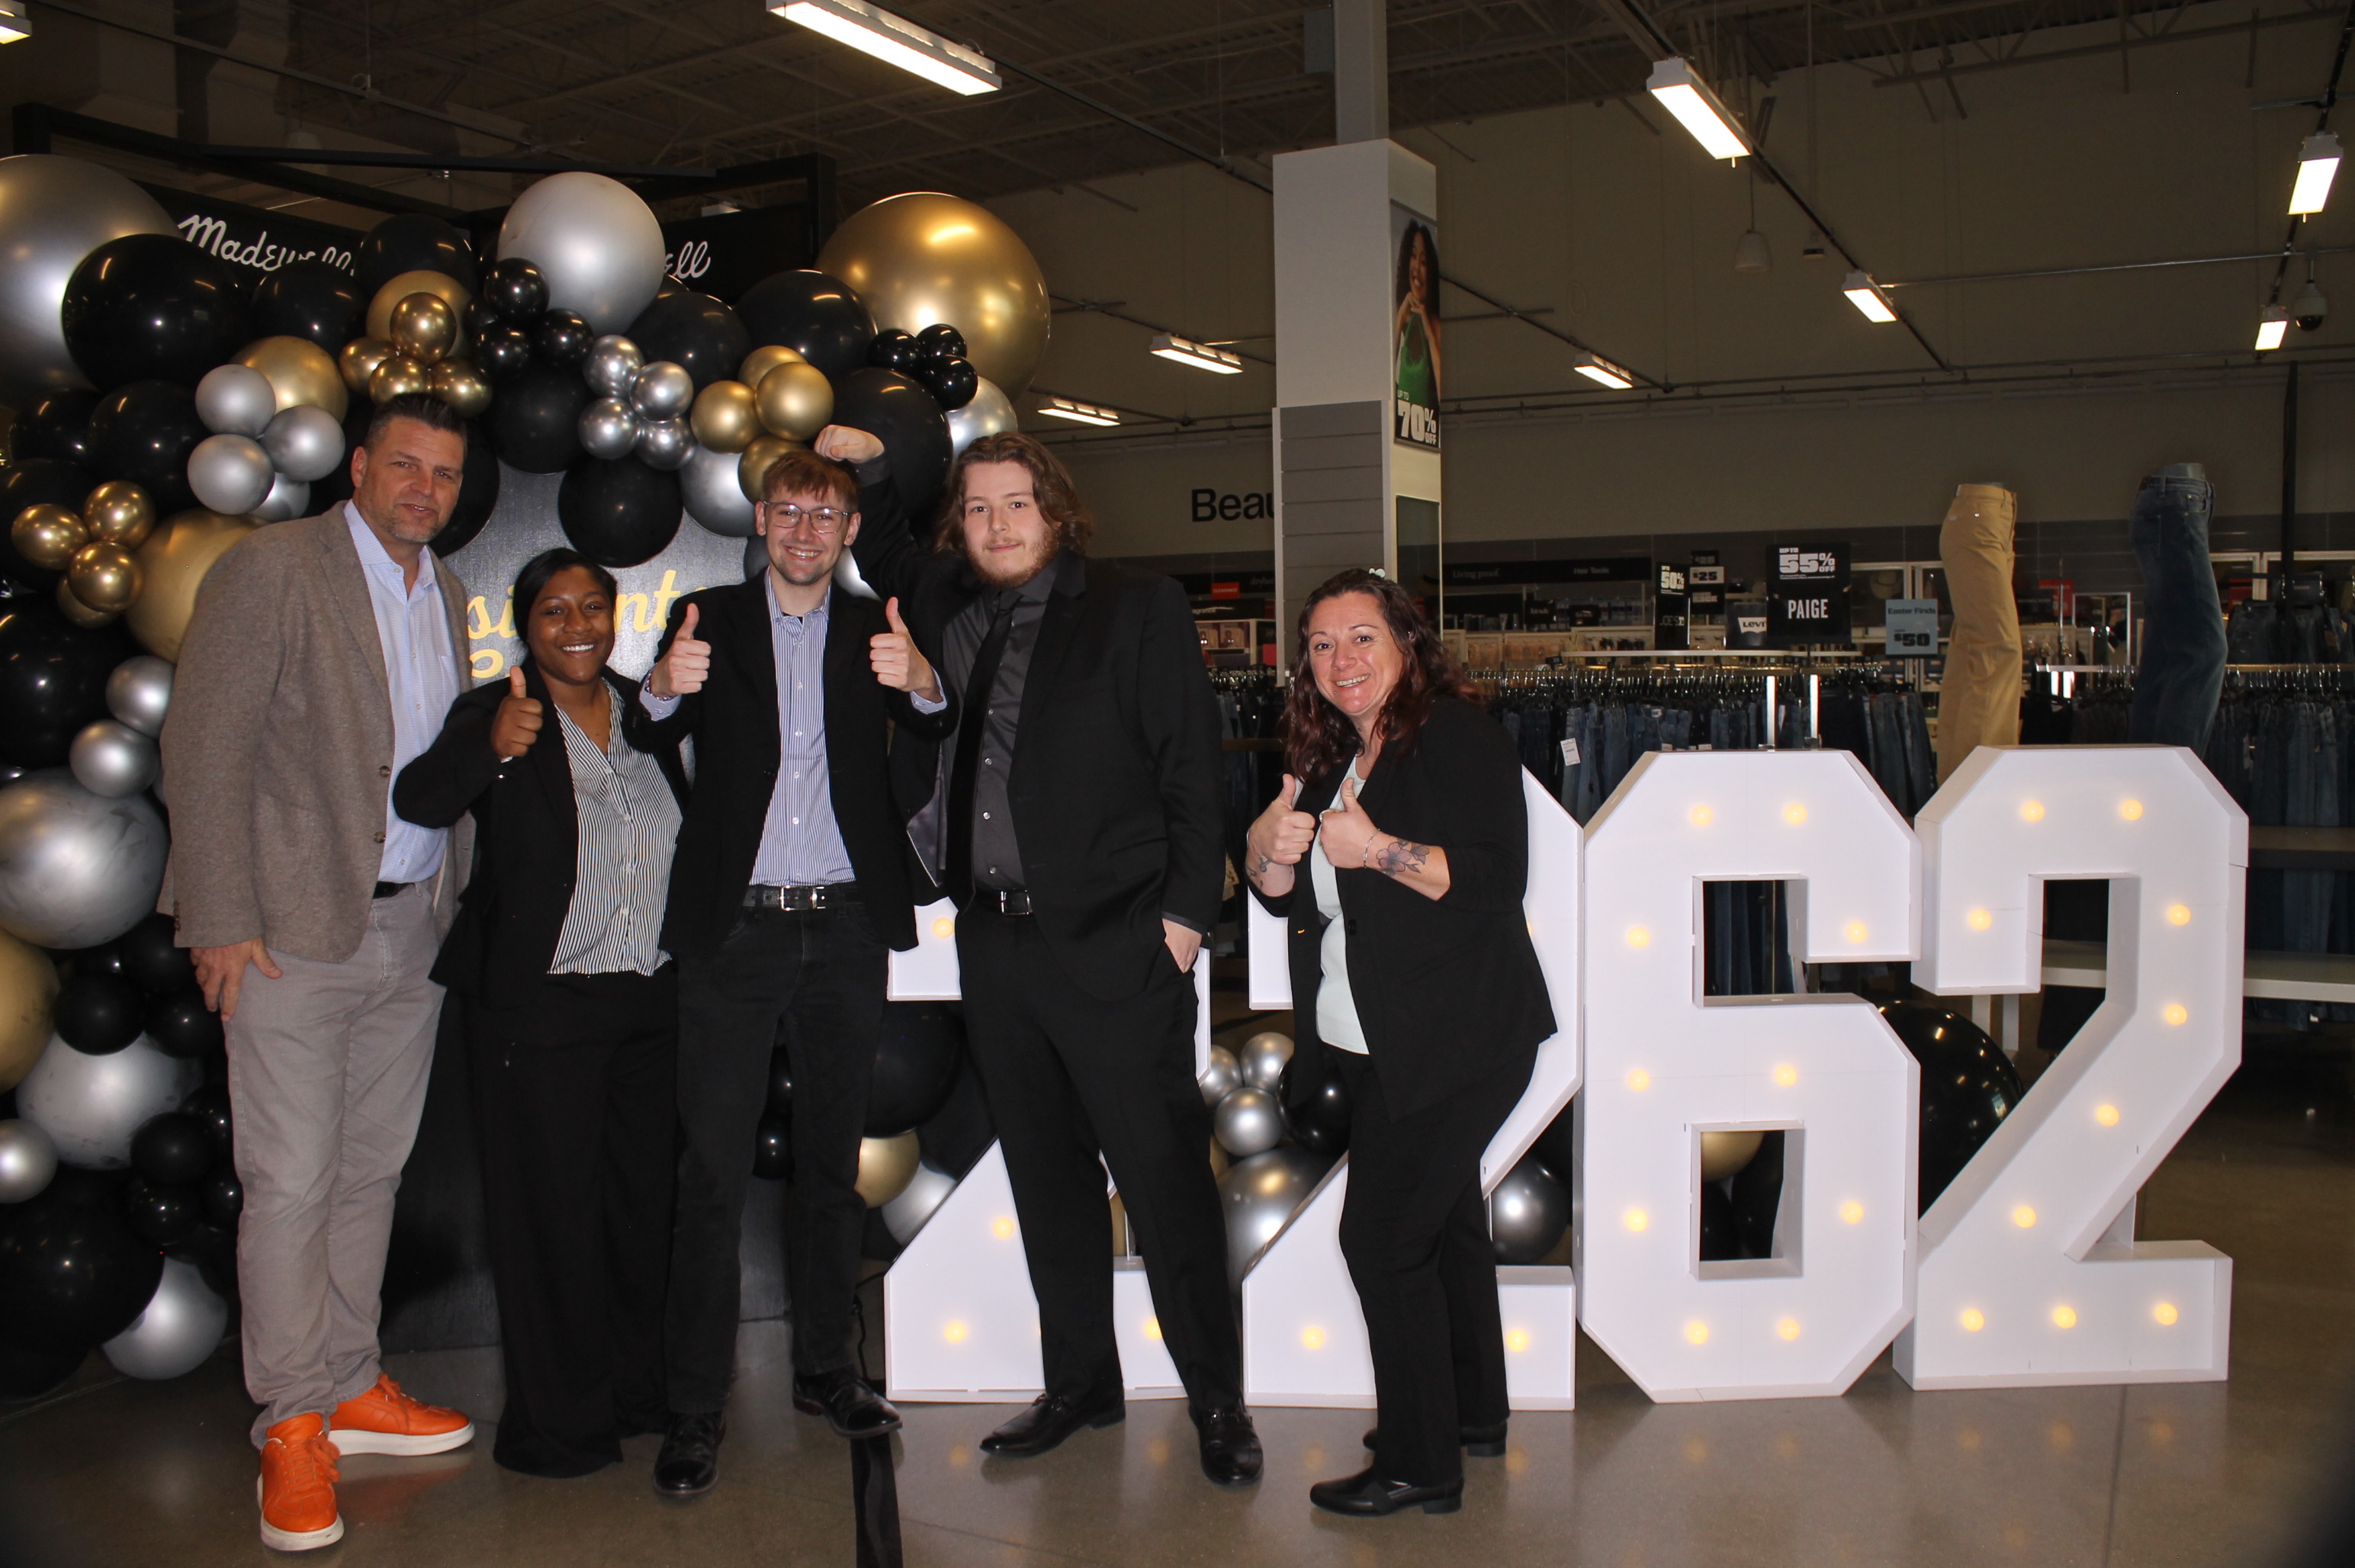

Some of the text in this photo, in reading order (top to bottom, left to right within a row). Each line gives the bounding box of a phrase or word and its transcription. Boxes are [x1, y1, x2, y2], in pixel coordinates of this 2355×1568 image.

[1397, 399, 1437, 442] 70%
[1425, 432, 1437, 445] OFF
[1590, 566, 1610, 574] Tools
[1779, 552, 1836, 574] 55%
[1453, 570, 1477, 580] Living
[1661, 571, 1685, 590] 50%
[1693, 570, 1718, 581] $25
[1788, 599, 1830, 619] PAIGE
[1894, 633, 1930, 647] $50
